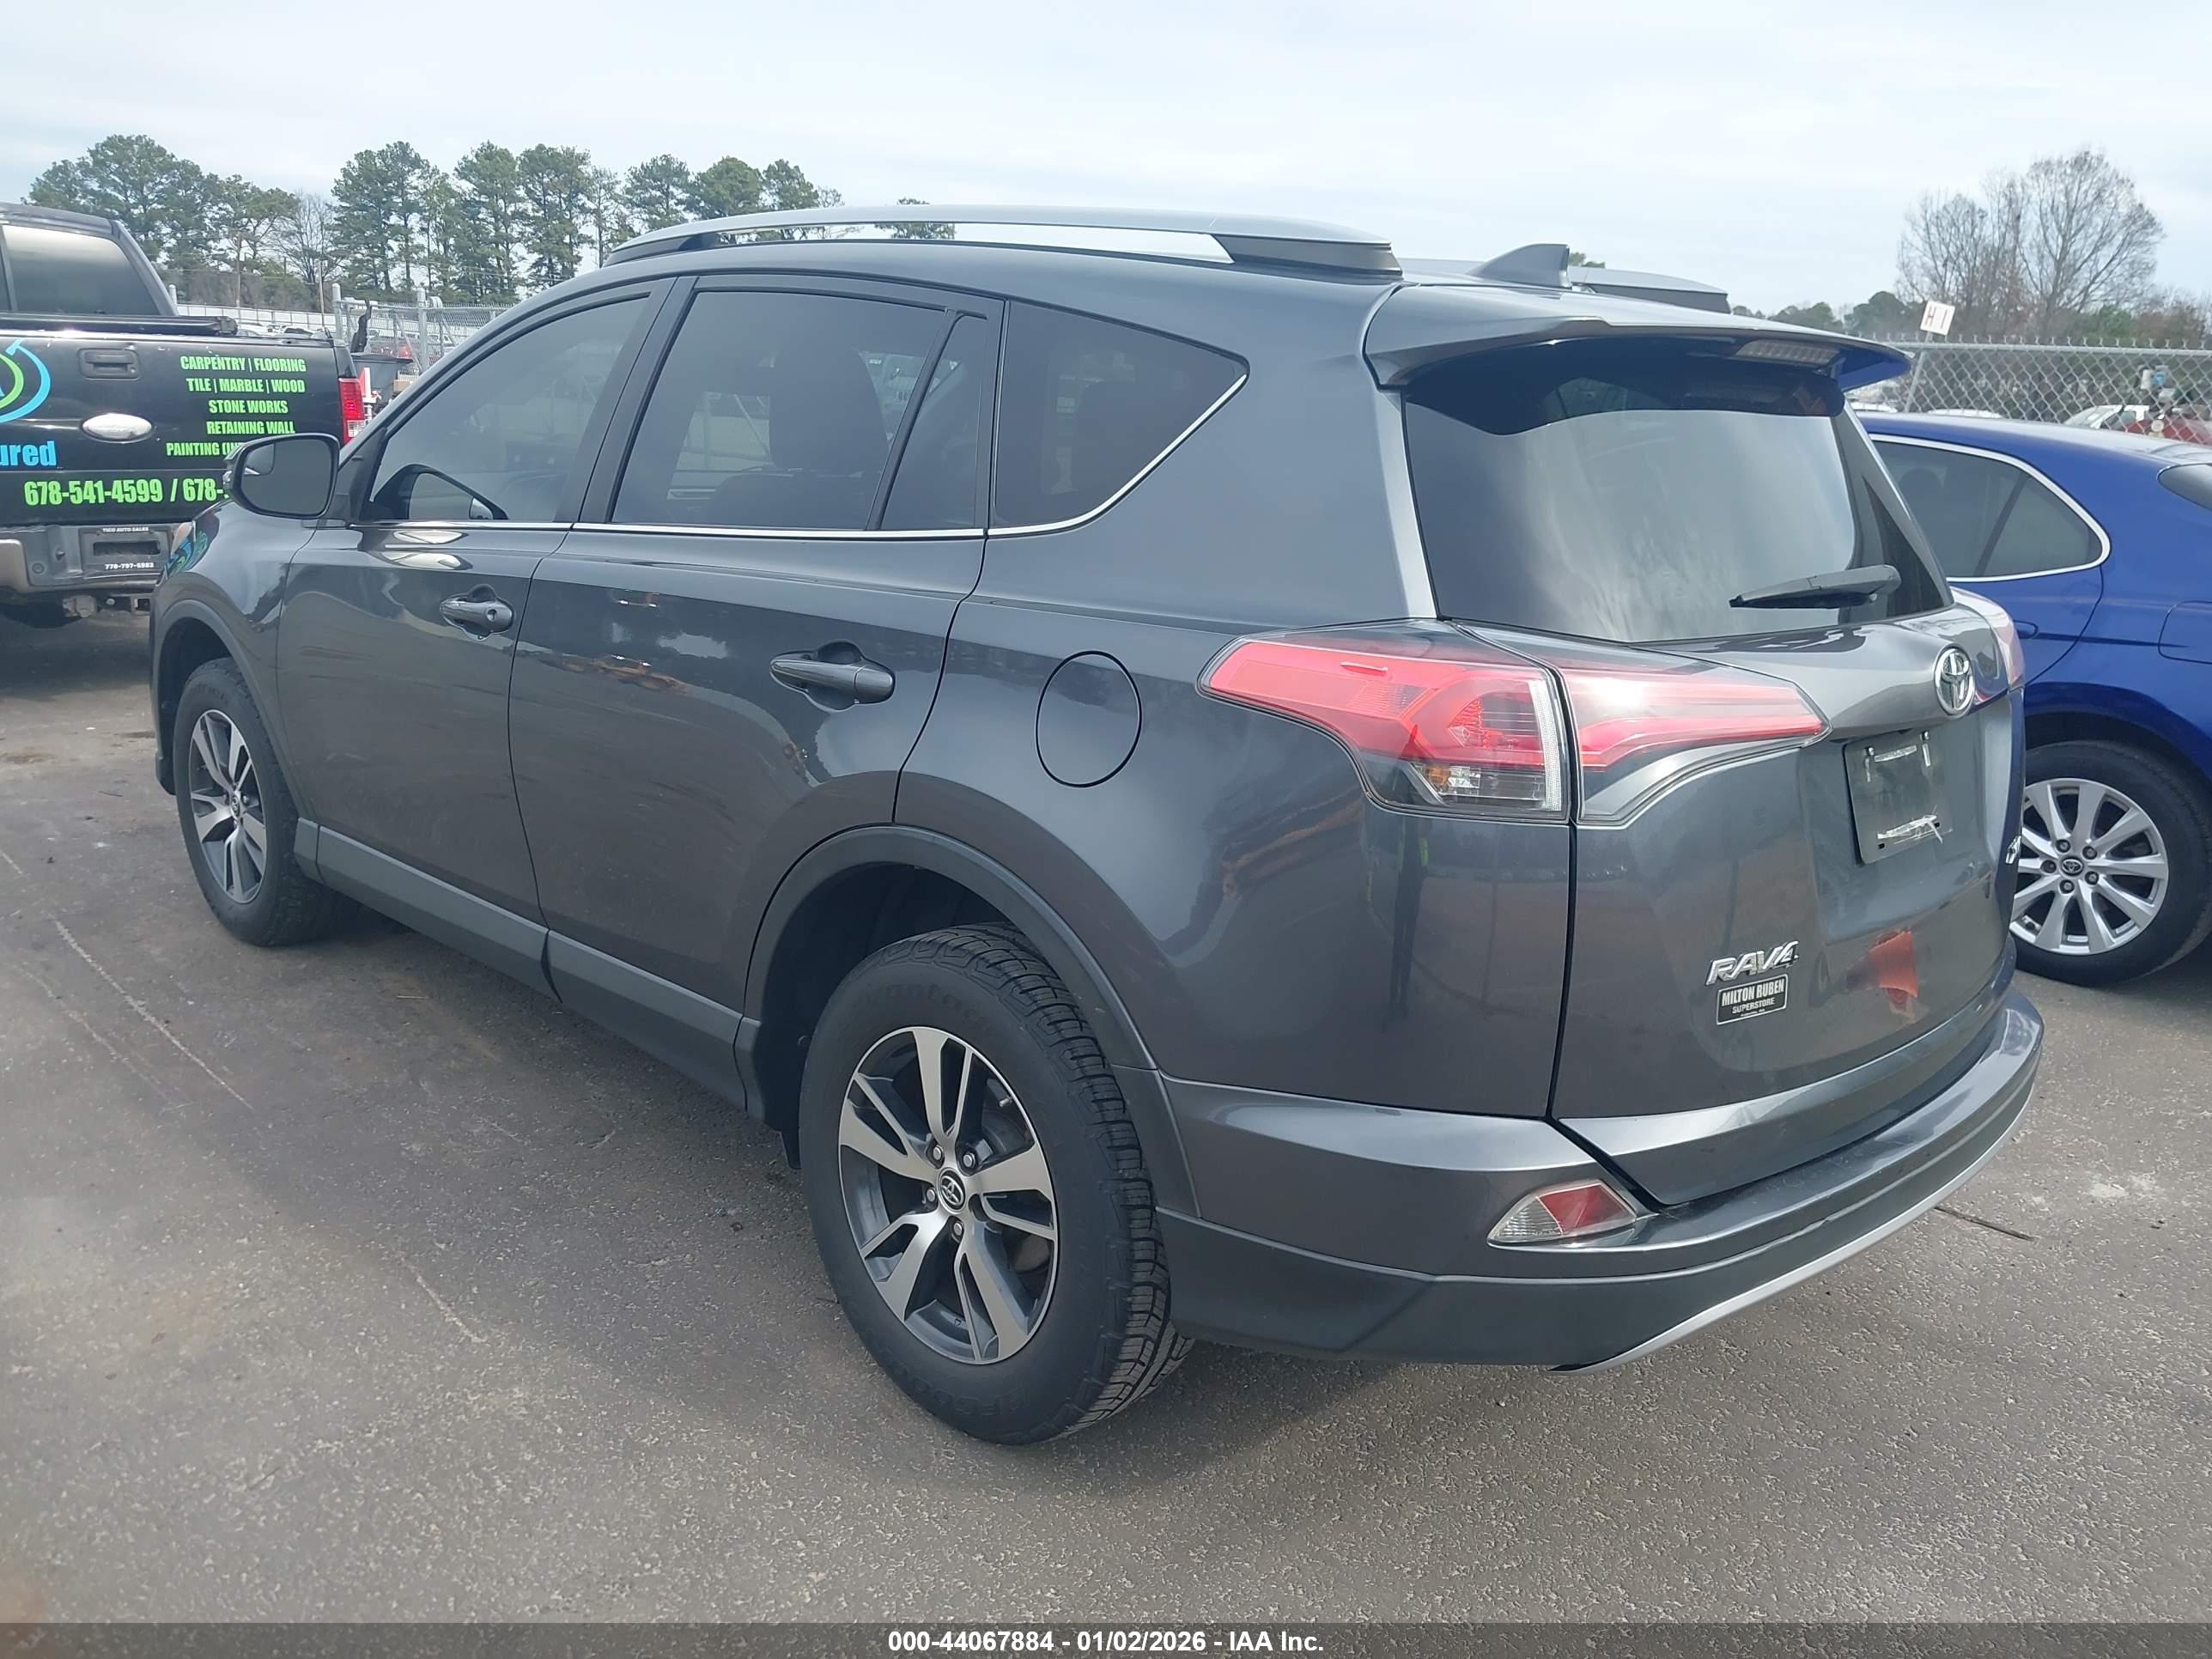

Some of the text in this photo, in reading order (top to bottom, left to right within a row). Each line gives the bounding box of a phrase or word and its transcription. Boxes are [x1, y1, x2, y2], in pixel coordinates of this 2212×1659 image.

[180, 356, 246, 371] CARPENTRY
[253, 357, 307, 372] FLOORING
[185, 378, 212, 392] TILE
[218, 378, 264, 392] MARBLE
[270, 379, 305, 392] WOOD
[208, 399, 289, 414] STONE WORKS
[206, 421, 295, 434] RETAINING WALL
[166, 442, 221, 456] PAINTING
[24, 479, 163, 506] 678-541-4599
[182, 477, 230, 501] 678-
[1722, 978, 1784, 1006] MILTON RUBEN
[1732, 997, 1775, 1014] SUPERSTORE
